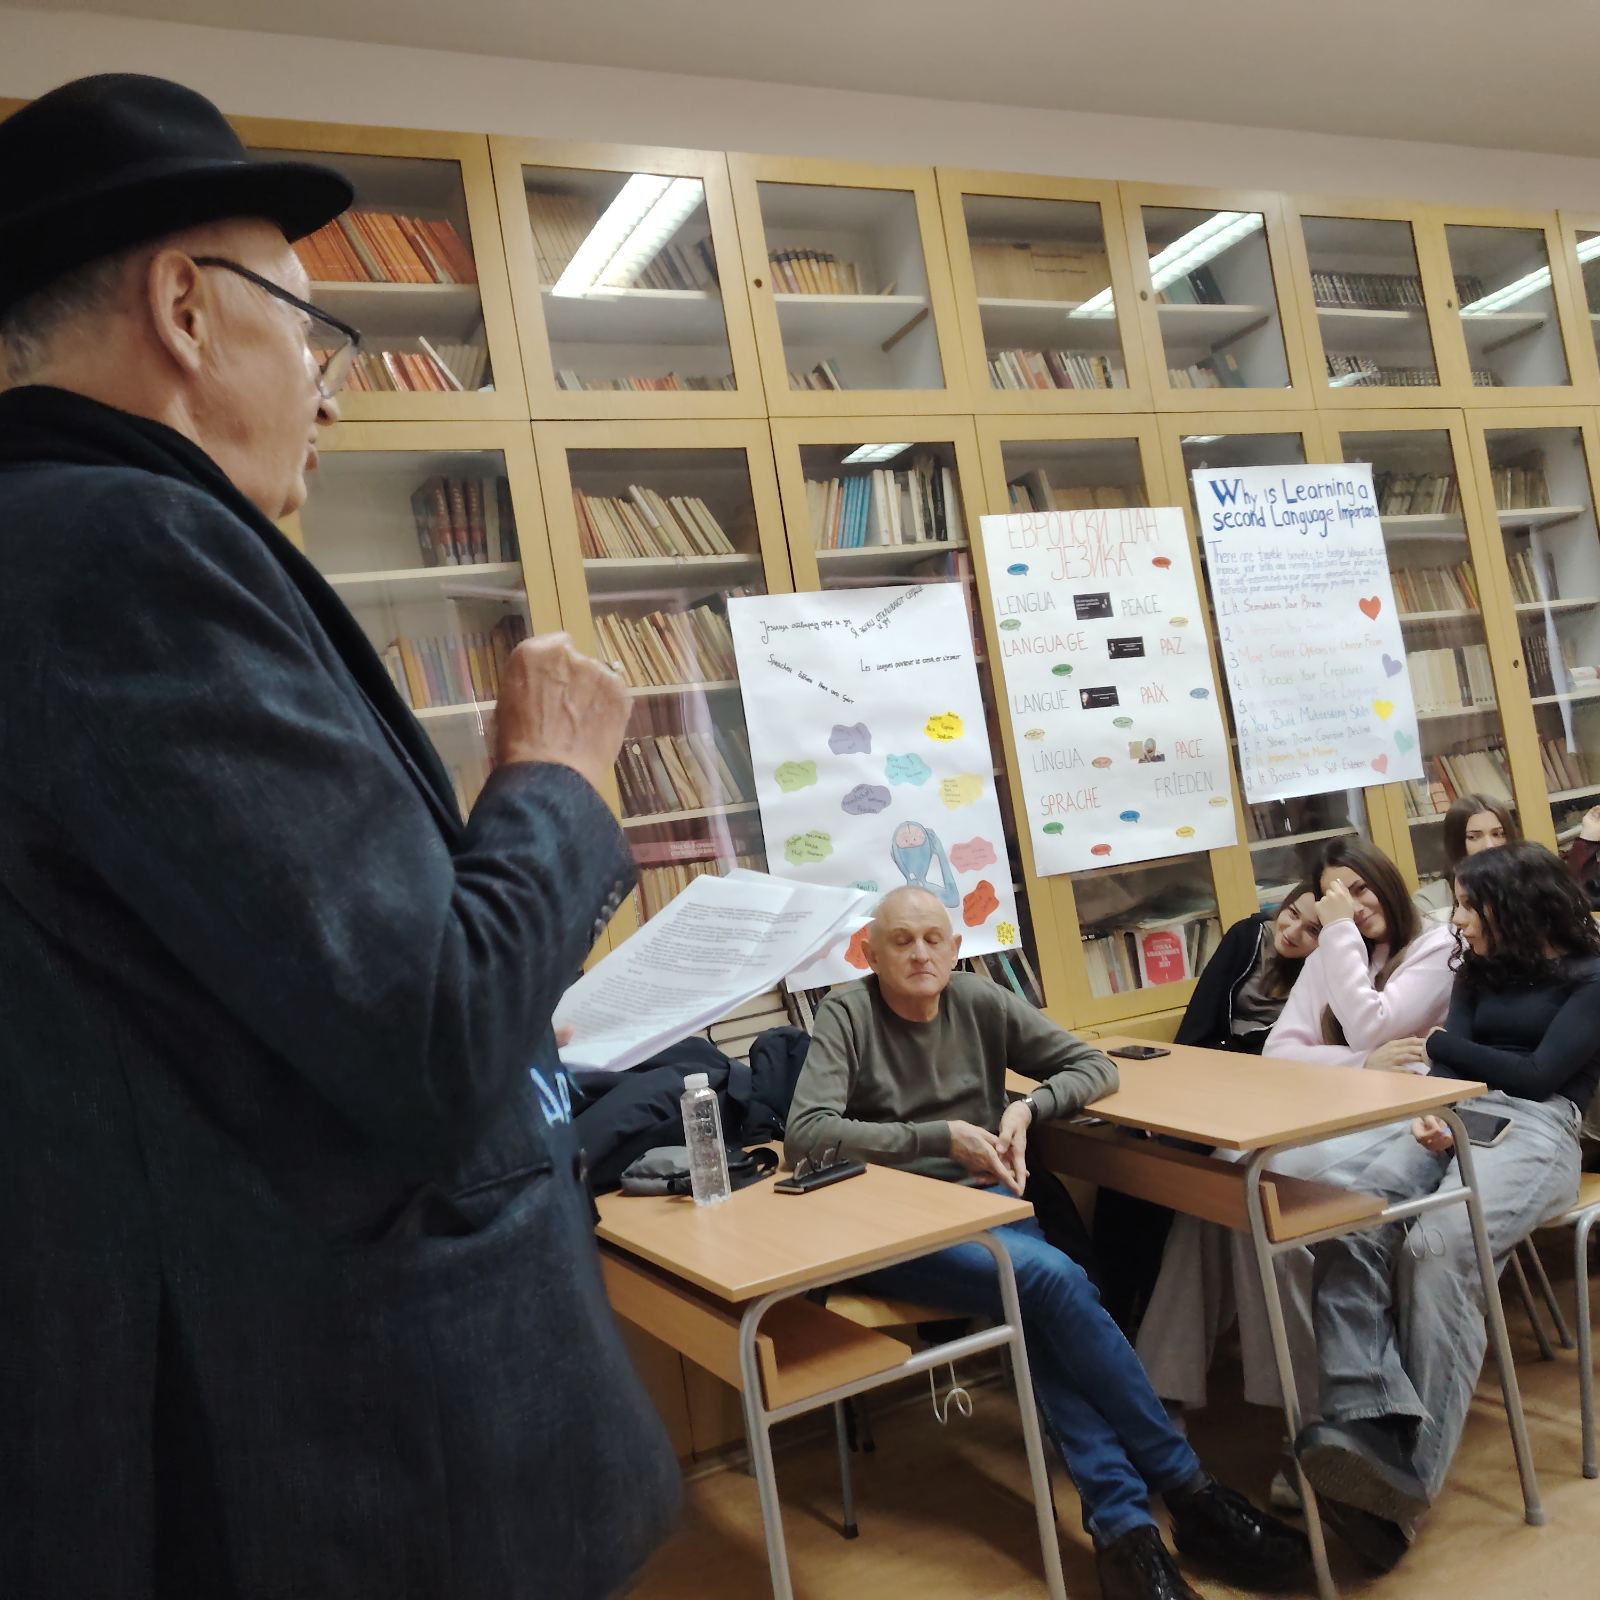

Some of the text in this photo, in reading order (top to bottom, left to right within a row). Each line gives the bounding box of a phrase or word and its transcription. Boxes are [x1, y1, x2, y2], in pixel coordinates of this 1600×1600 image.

[1208, 478, 1368, 513] Why is Learning a
[1006, 508, 1160, 549] ЕВРОПСКИ ДАН
[1213, 506, 1266, 531] second
[1270, 505, 1335, 537] Language
[1047, 542, 1134, 580] ЈЕЗИКА
[996, 592, 1056, 616] LENGUA
[1121, 594, 1163, 617] PEACE
[1002, 632, 1089, 657] LANGUAGE
[1160, 636, 1184, 655] PAZ
[1014, 689, 1071, 715] LANGUE
[1174, 738, 1205, 759] PACE
[1040, 787, 1101, 816] SPRACHE
